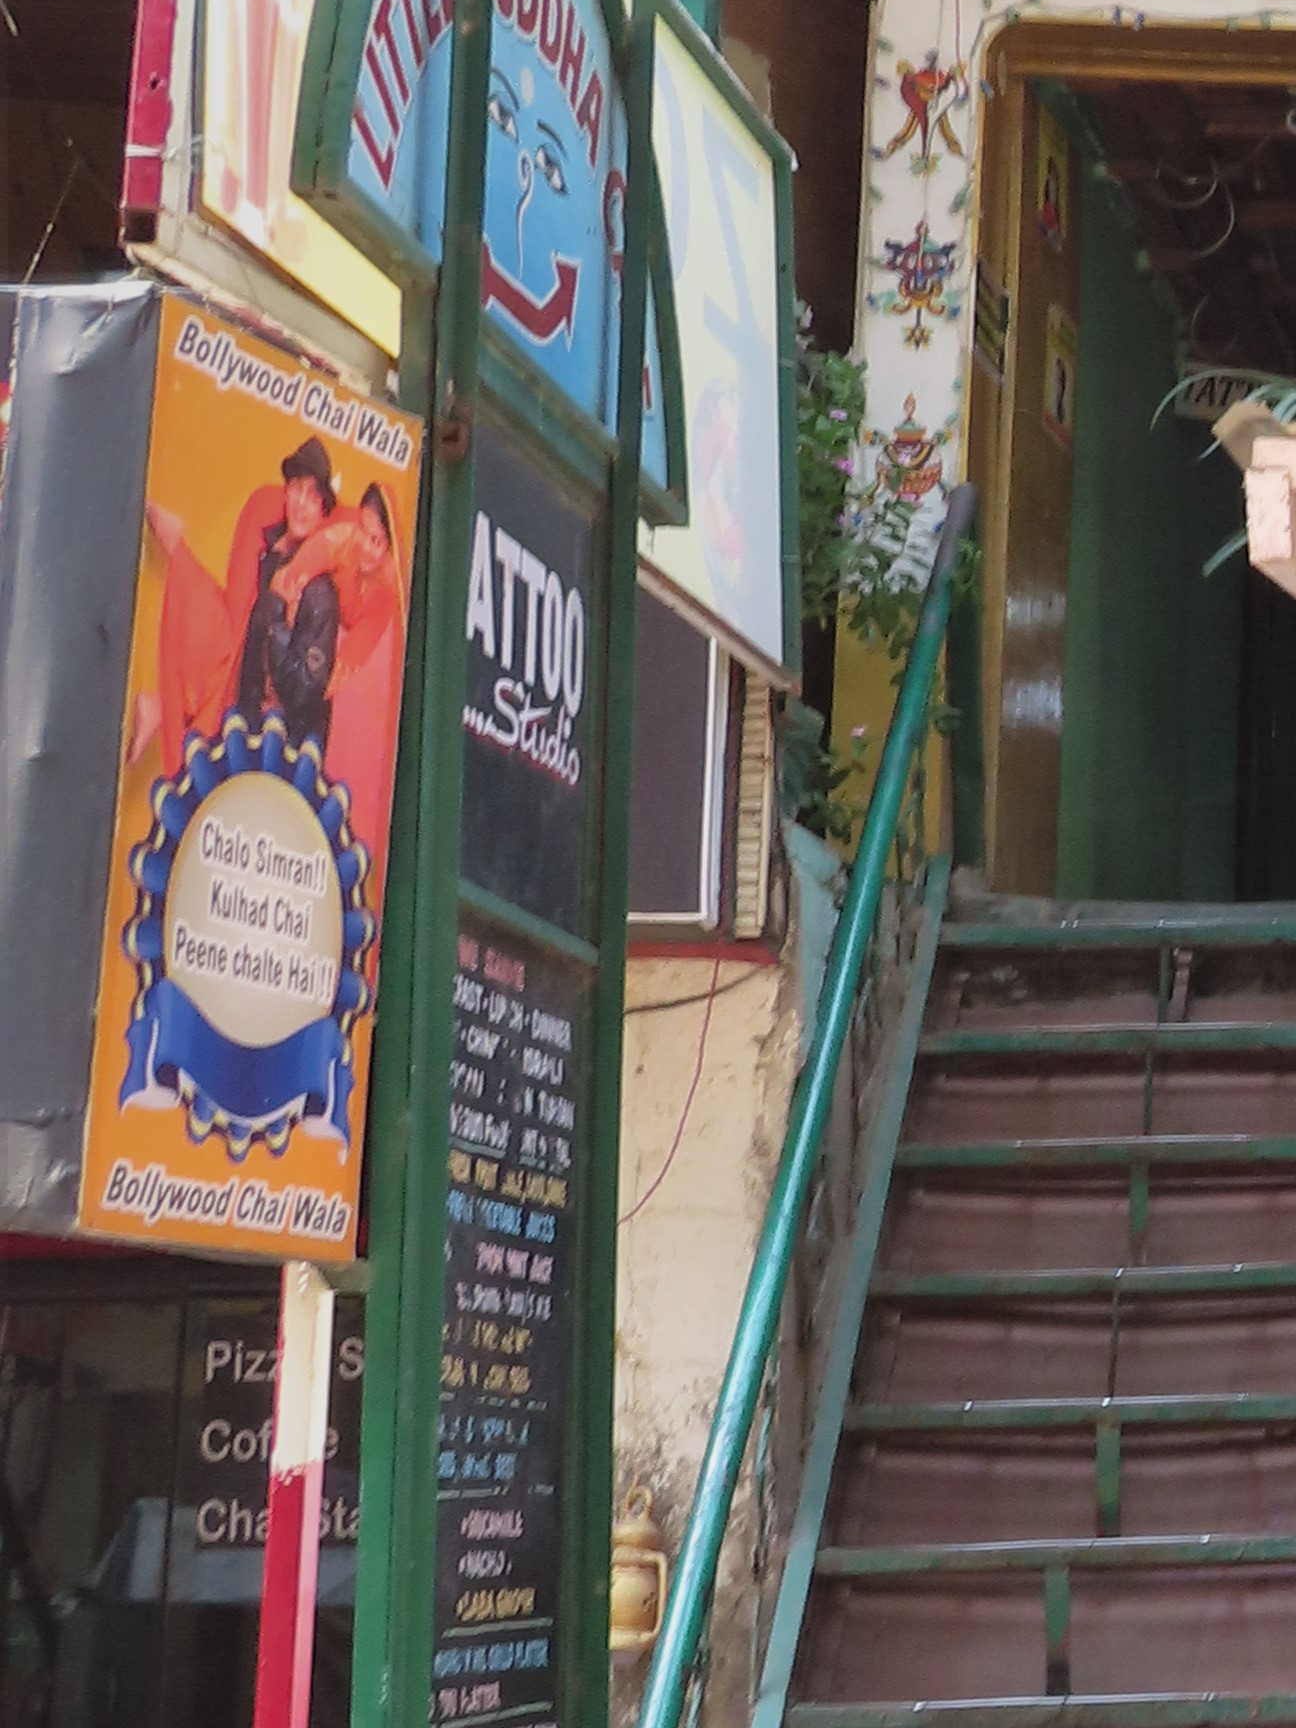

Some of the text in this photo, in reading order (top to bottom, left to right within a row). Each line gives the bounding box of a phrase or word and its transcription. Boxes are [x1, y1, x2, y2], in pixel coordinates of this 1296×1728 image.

[178, 318, 411, 465] Bollywood Chai Wala
[466, 510, 587, 719] ATTOO
[202, 821, 250, 870] Chalo
[210, 878, 311, 941] Kulhad Chai
[174, 925, 228, 973] Peene
[232, 941, 284, 987] chalte
[287, 954, 317, 994] Hai
[105, 1164, 349, 1235] Bollywood Chai Wala
